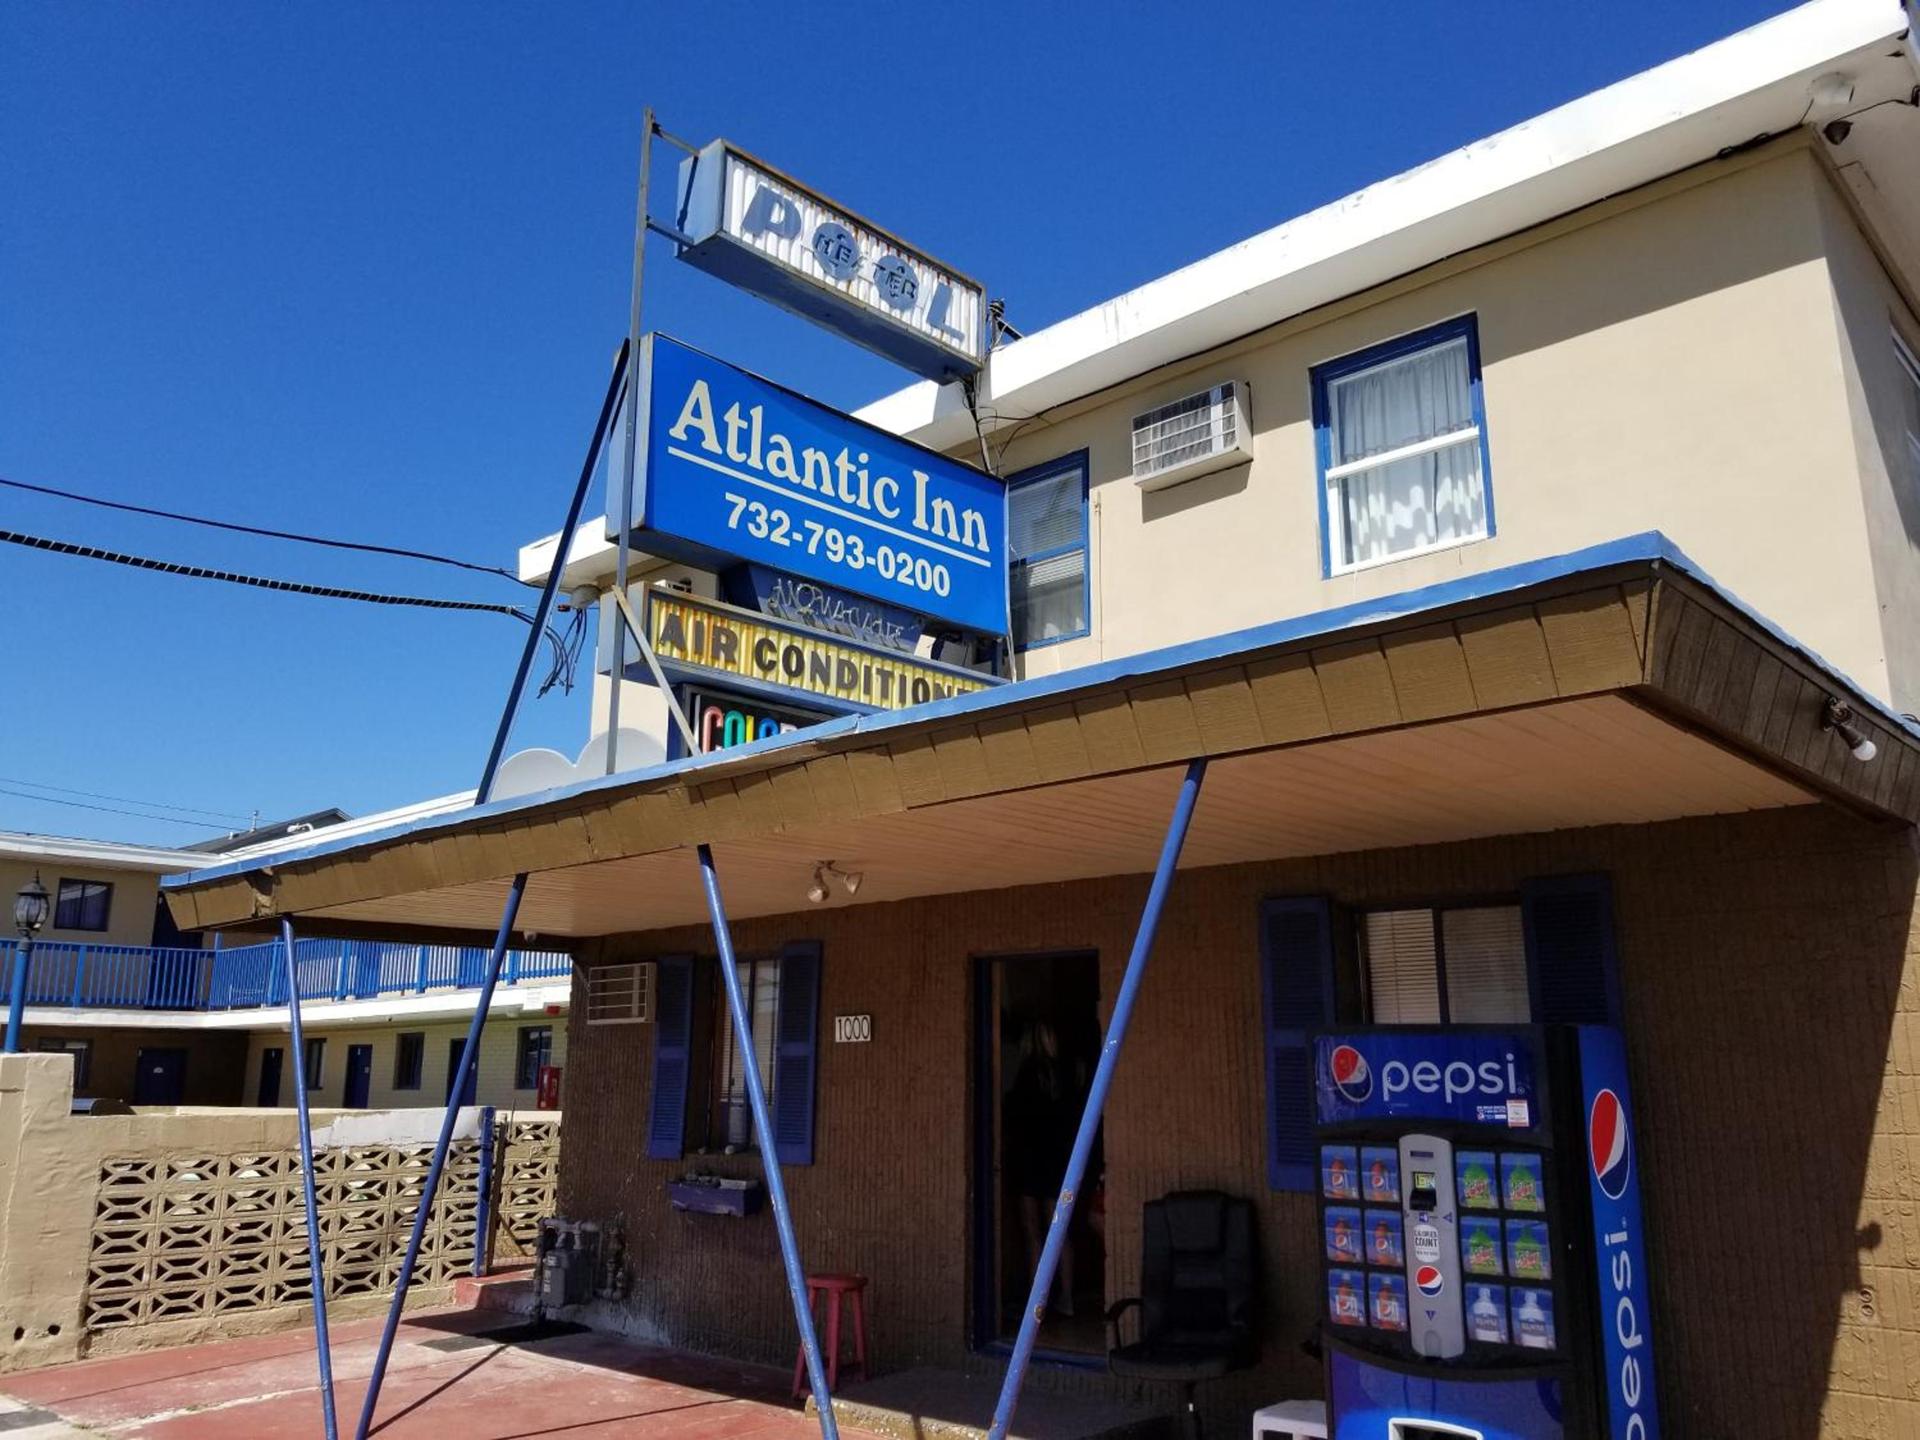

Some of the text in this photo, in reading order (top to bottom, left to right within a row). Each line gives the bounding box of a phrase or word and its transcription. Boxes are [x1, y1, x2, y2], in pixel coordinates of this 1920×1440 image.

[668, 378, 991, 554] Atlantic Inn
[725, 492, 951, 598] 732-793-0200
[659, 613, 975, 704] AIR CONDITION
[838, 1016, 870, 1041] 1000
[1382, 1053, 1516, 1104] pepsi
[1415, 1237, 1438, 1247] COUNT
